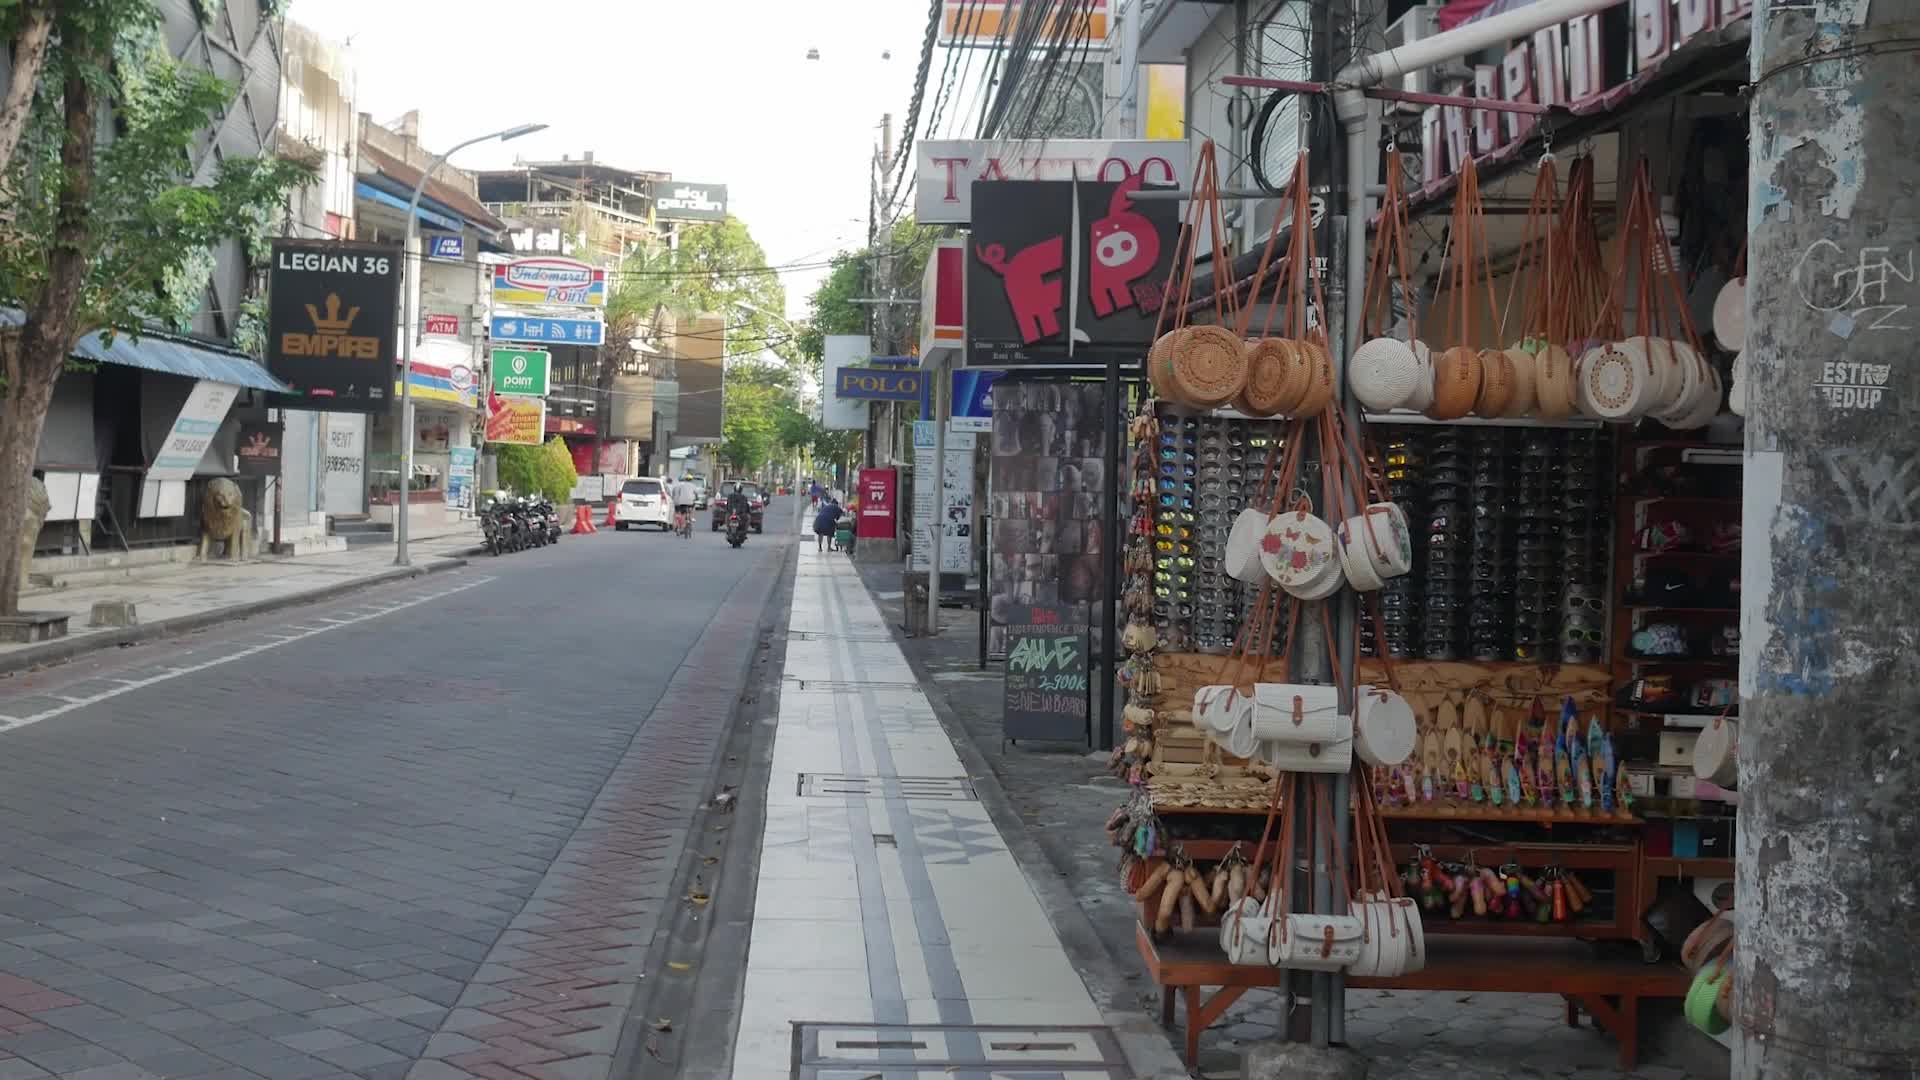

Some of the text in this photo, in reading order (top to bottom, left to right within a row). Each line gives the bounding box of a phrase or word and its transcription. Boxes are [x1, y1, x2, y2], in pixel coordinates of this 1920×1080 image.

[279, 252, 390, 275] LEGIAN 36
[511, 268, 586, 280] Indomaret
[546, 287, 588, 304] Point
[431, 322, 454, 334] ATM
[843, 376, 917, 393] POLO
[331, 432, 353, 448] RENT
[1009, 636, 1078, 672] SALE
